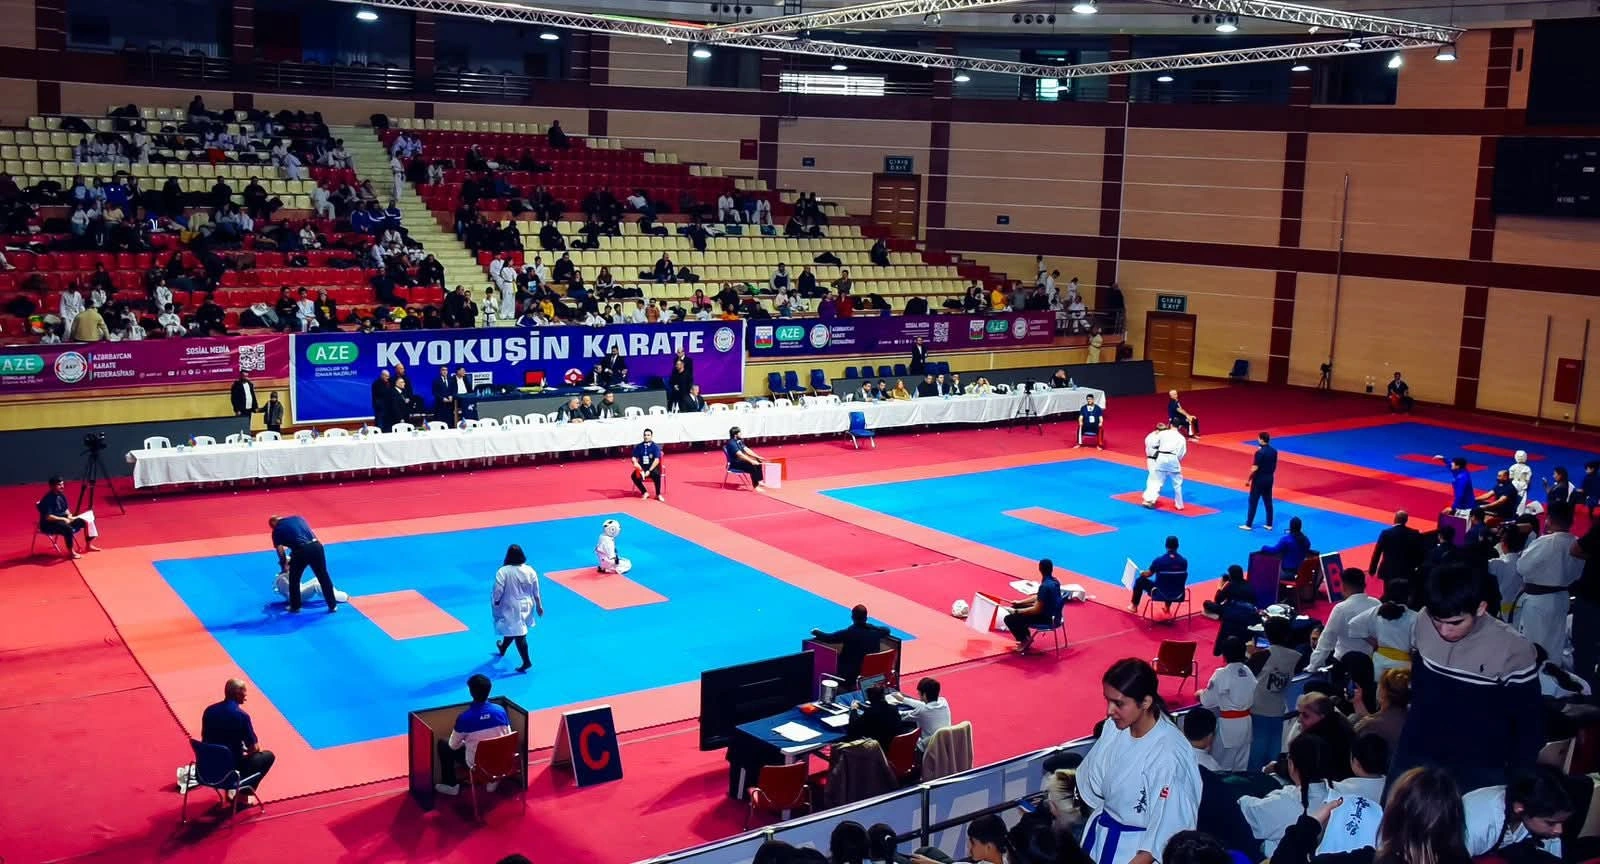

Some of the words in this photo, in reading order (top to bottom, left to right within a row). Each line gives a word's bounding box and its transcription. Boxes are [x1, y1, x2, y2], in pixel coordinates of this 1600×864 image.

[781, 328, 800, 338] AZE
[315, 345, 349, 361] AZE
[376, 331, 569, 368] KYOKUŞİN
[583, 330, 704, 358] KARATE
[2, 358, 35, 371] AZE
[1328, 563, 1344, 593] B
[580, 723, 610, 770] C
